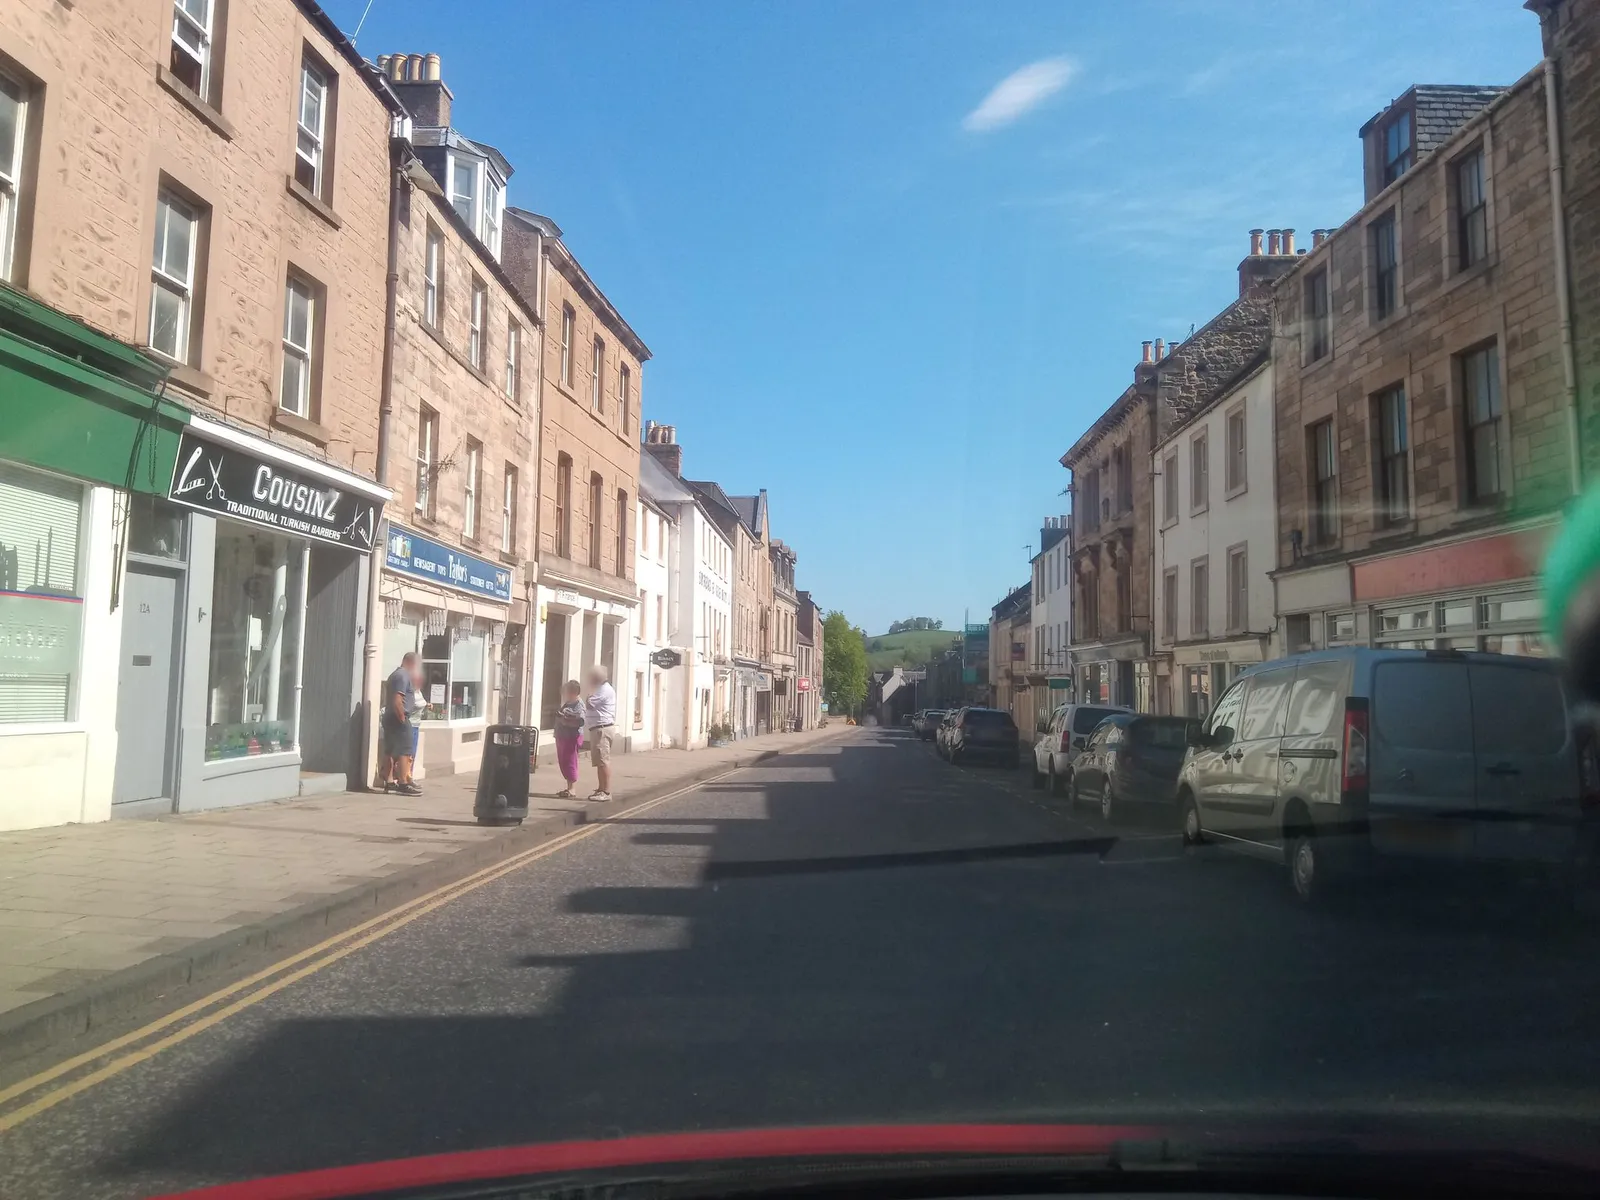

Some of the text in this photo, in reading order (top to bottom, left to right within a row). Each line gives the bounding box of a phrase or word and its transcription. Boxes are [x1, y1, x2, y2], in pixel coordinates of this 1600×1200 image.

[252, 463, 342, 523] COUSINZ
[226, 500, 341, 541] TRADITIONAL TURKISH BARBERS
[413, 557, 436, 573] NEWSAGENT
[437, 565, 447, 577] TOYS
